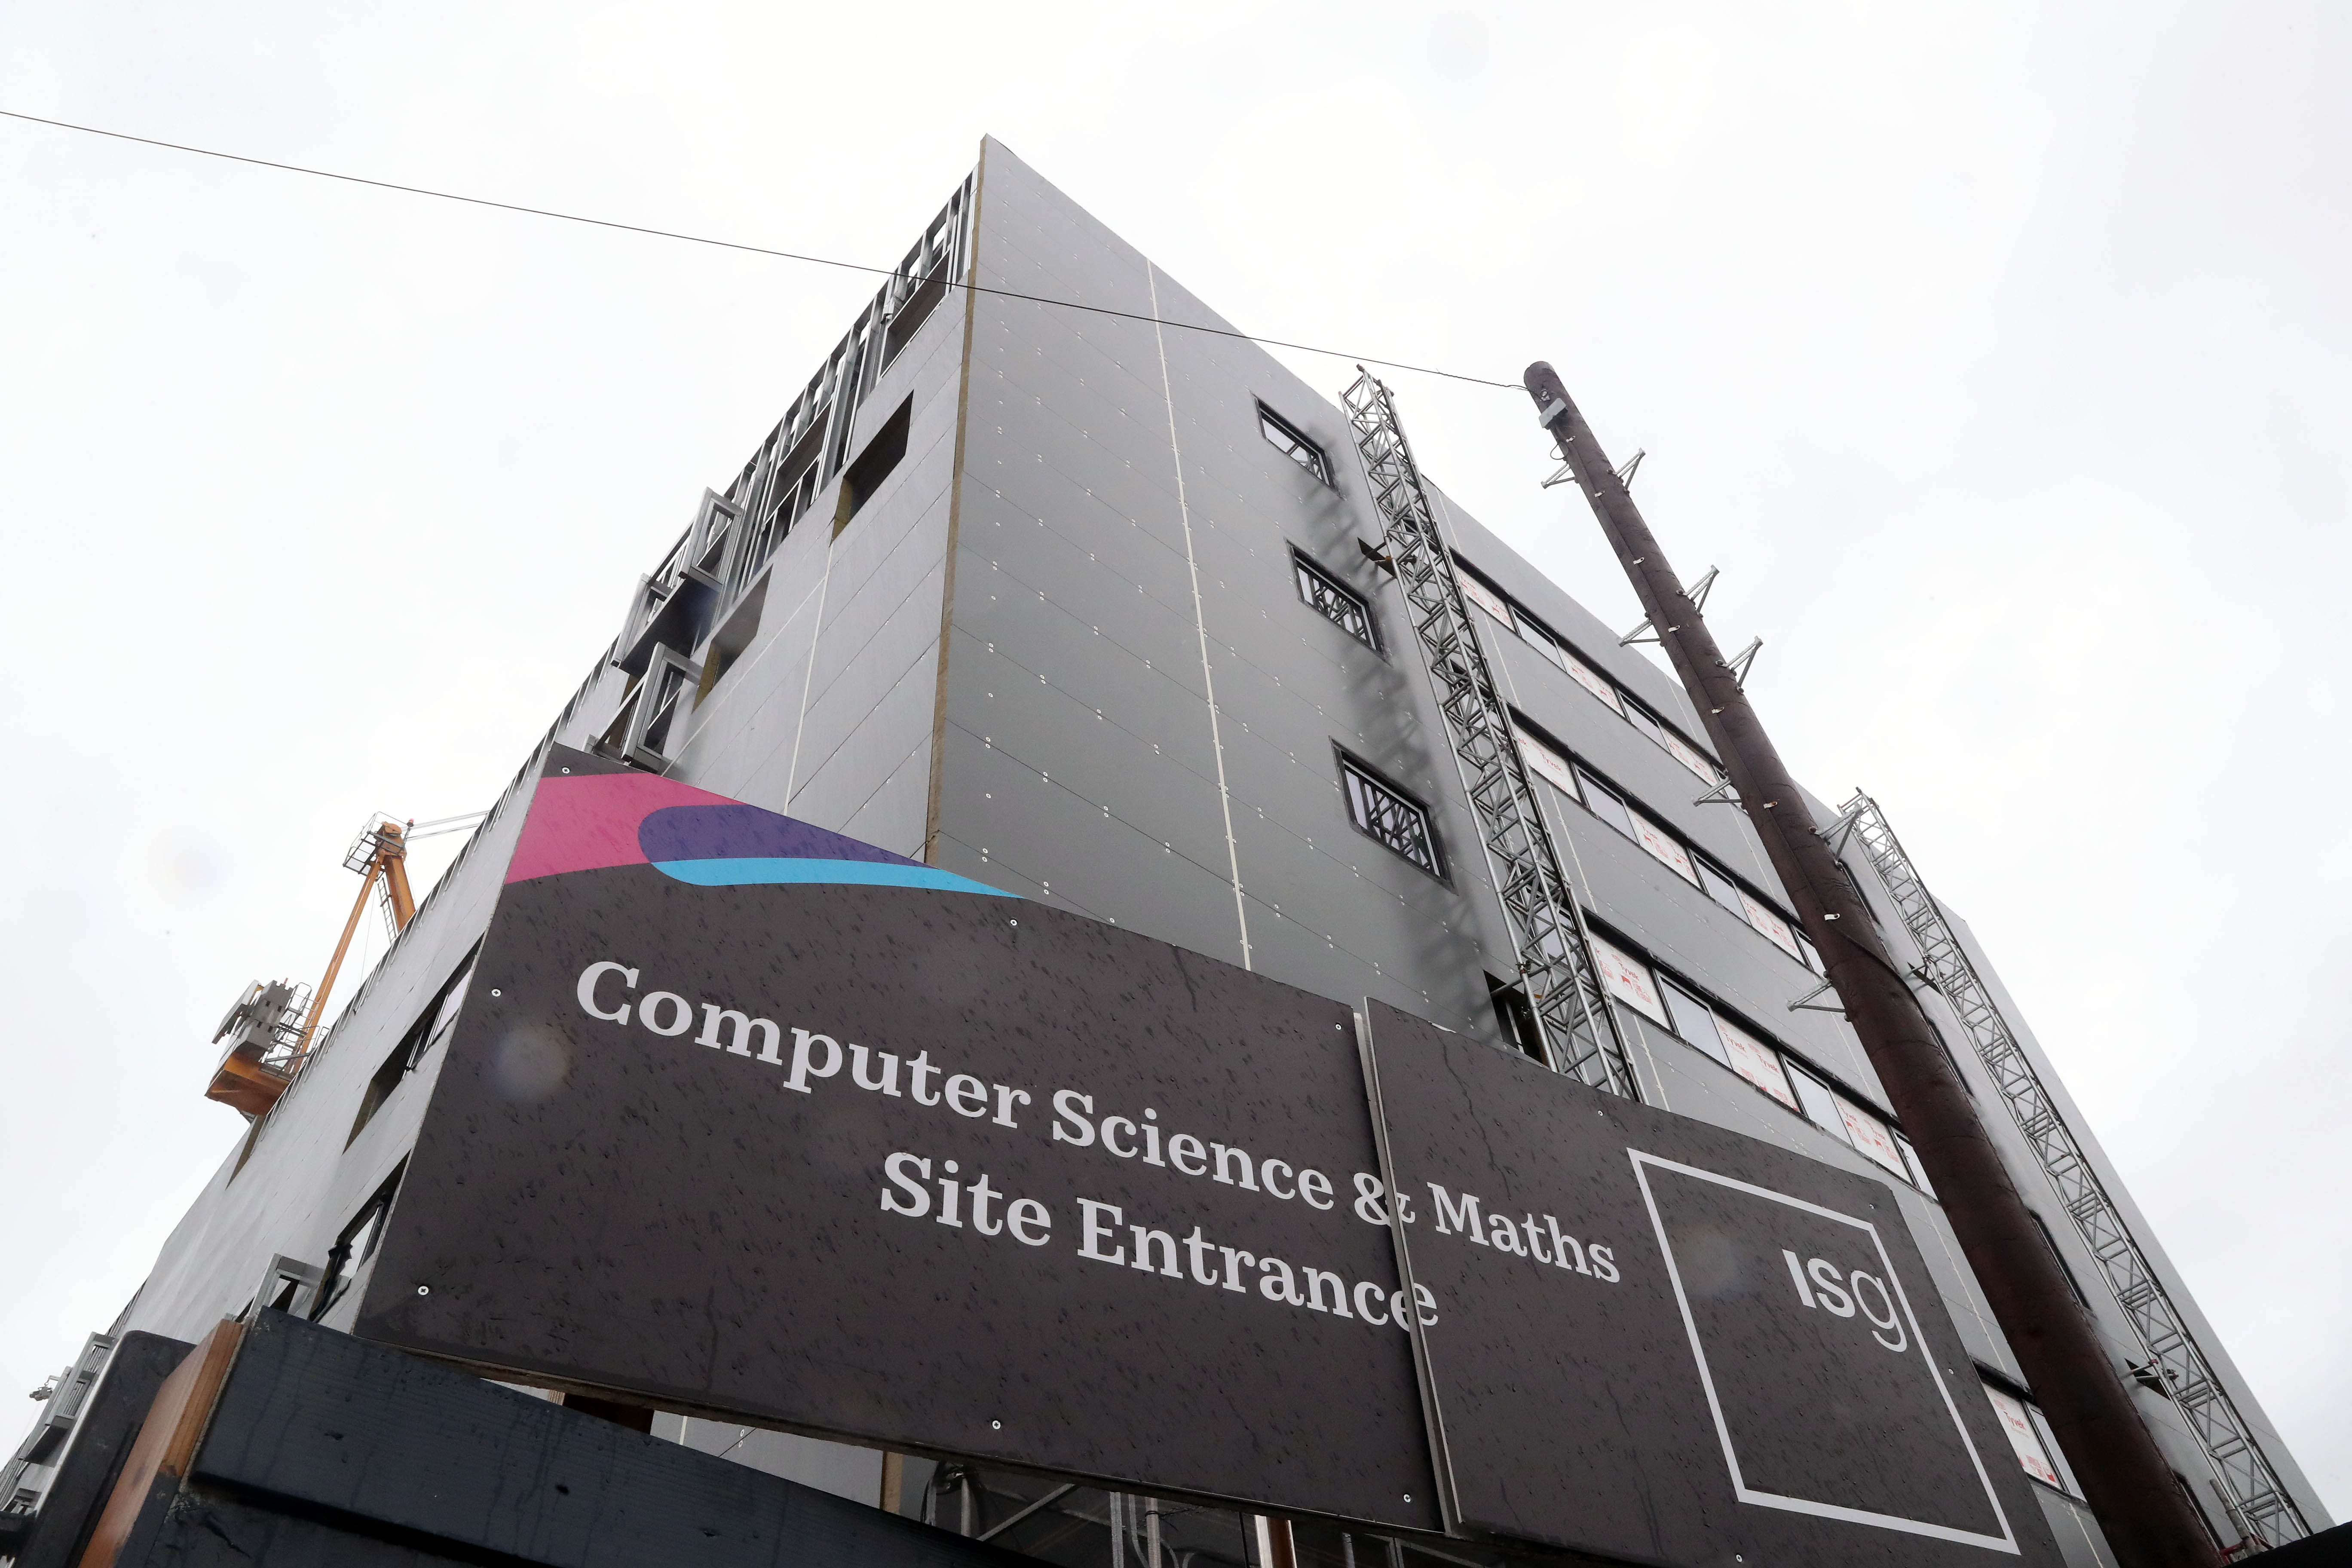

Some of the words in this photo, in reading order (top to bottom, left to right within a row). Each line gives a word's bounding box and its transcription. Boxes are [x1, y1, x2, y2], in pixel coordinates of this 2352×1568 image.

[1540, 752, 1561, 771] Tyvek
[1723, 1032, 1747, 1053] Tyvek
[1756, 1054, 1779, 1074] Tyvek
[577, 961, 1031, 1129] Computer
[1053, 1089, 1334, 1210] Science
[1353, 1173, 1416, 1228] &
[1427, 1182, 1620, 1283] Maths
[880, 1152, 1051, 1246] Site
[1077, 1197, 1439, 1332] Entrance
